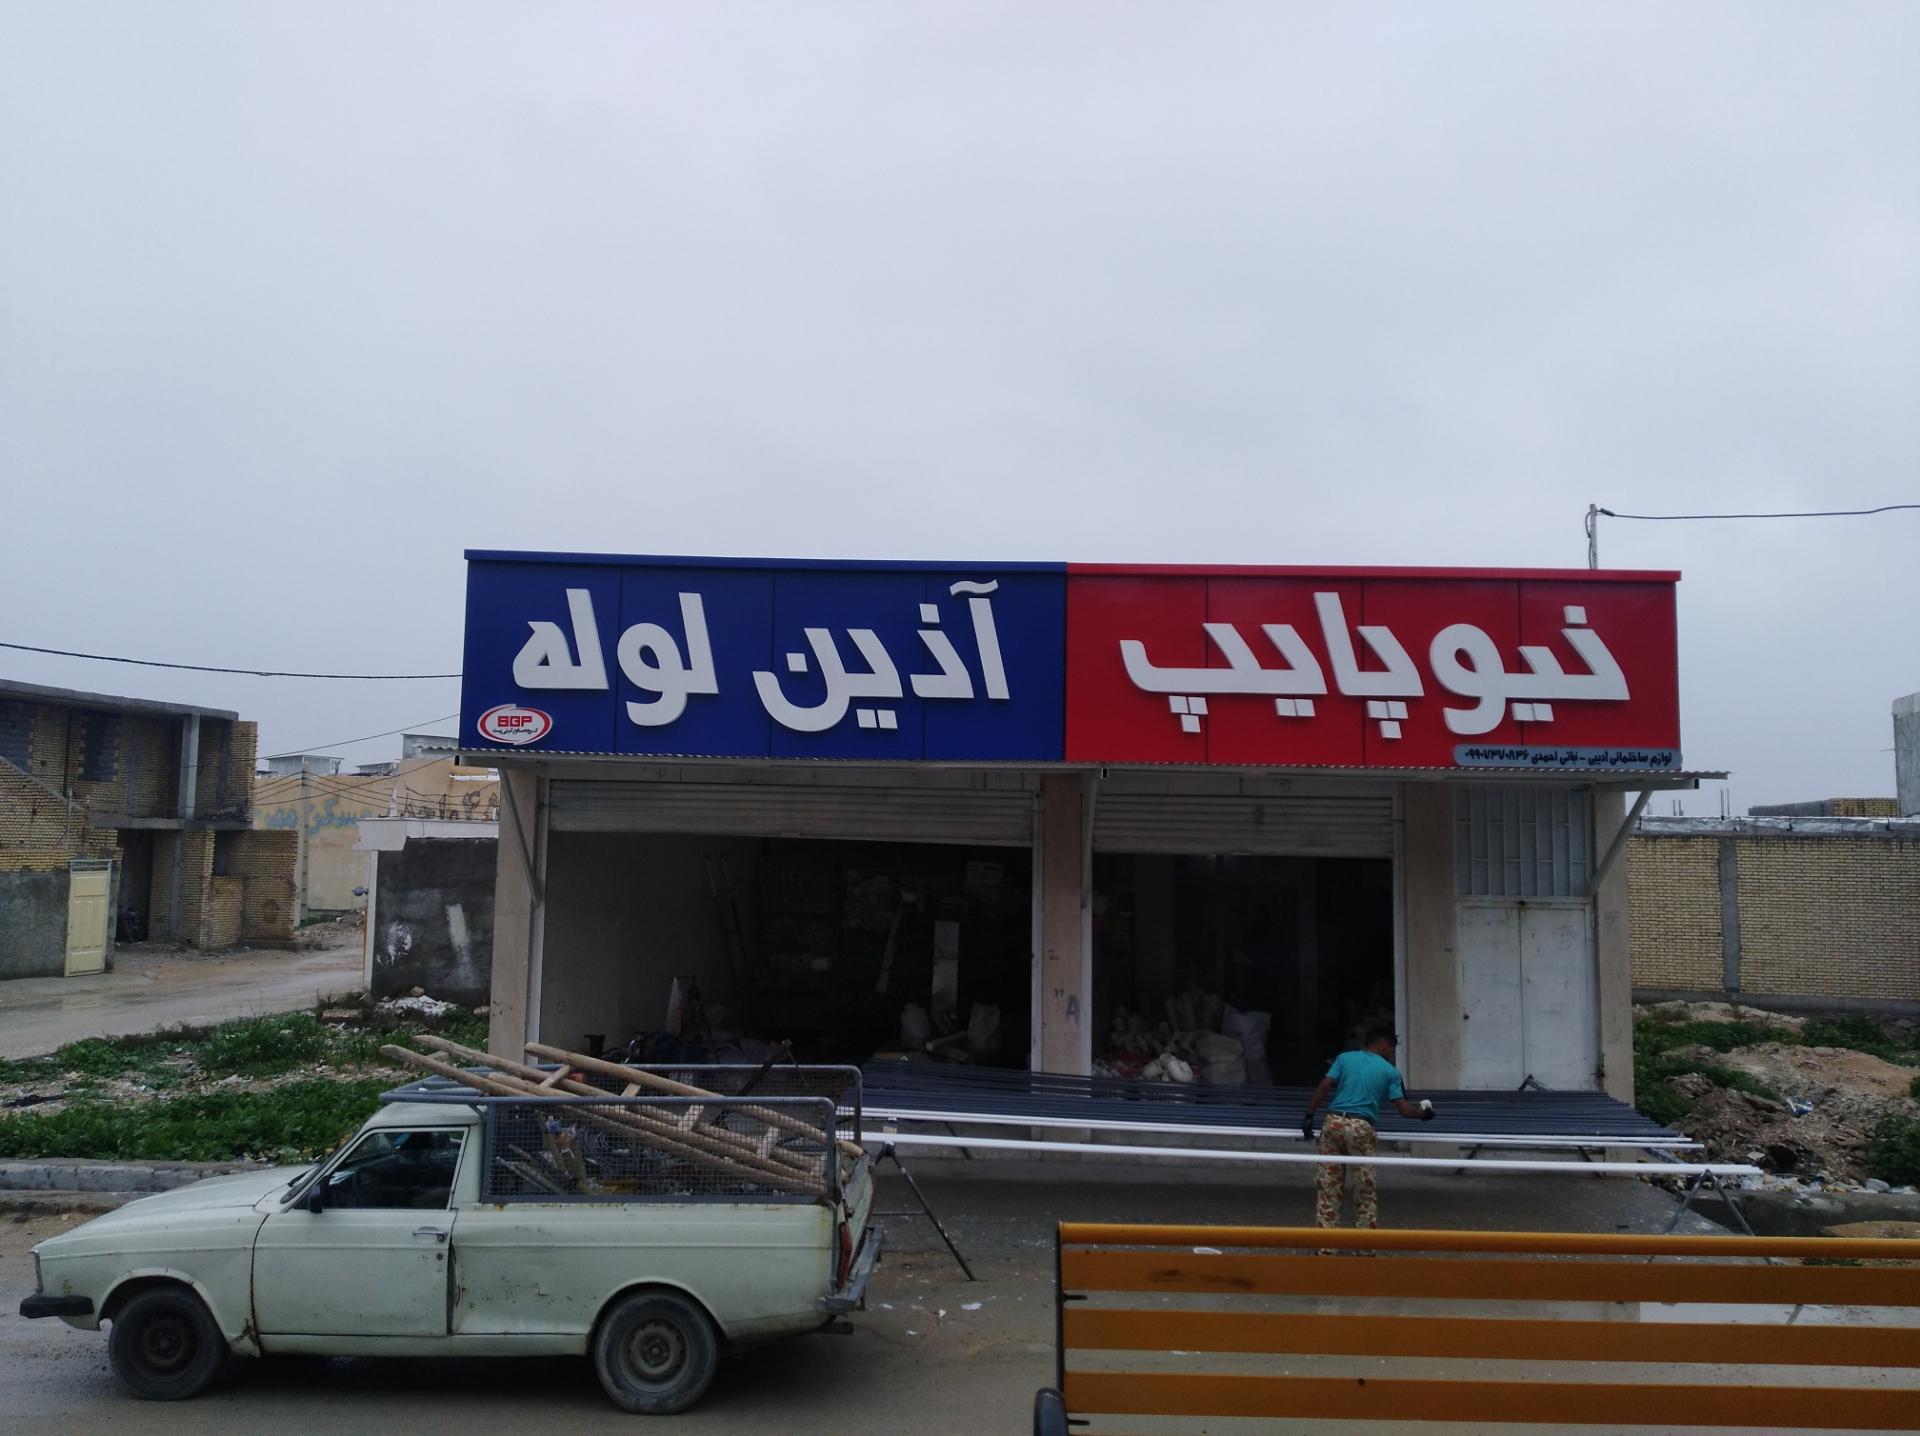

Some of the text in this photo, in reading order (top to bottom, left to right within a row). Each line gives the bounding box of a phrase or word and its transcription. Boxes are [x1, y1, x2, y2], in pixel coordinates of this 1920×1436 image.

[513, 580, 1009, 731] آذین لوله
[1531, 750, 1558, 764] احمدی
[1610, 751, 1648, 765] ساختمانی
[1650, 752, 1672, 767] لوازم
